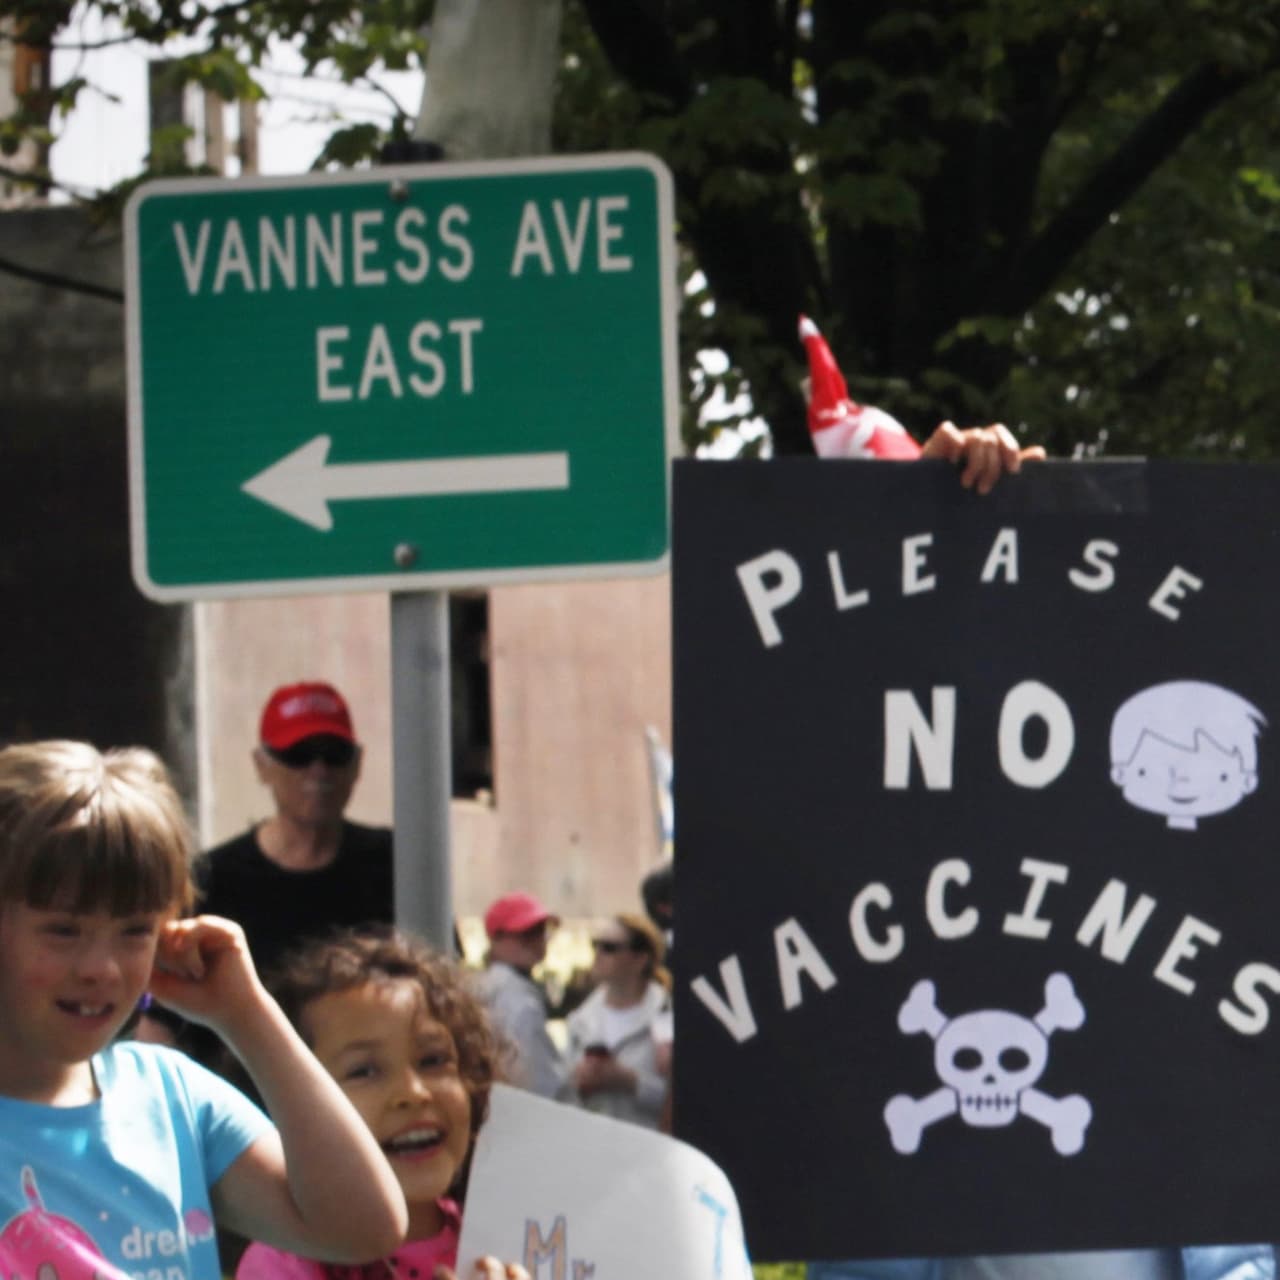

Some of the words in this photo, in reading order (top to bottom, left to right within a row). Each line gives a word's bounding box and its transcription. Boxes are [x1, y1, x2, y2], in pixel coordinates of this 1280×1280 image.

[173, 204, 474, 296] VANNESS
[510, 196, 634, 278] AVE
[316, 318, 484, 402] EAST
[736, 528, 1204, 648] PLEASE
[883, 680, 1076, 790] NO
